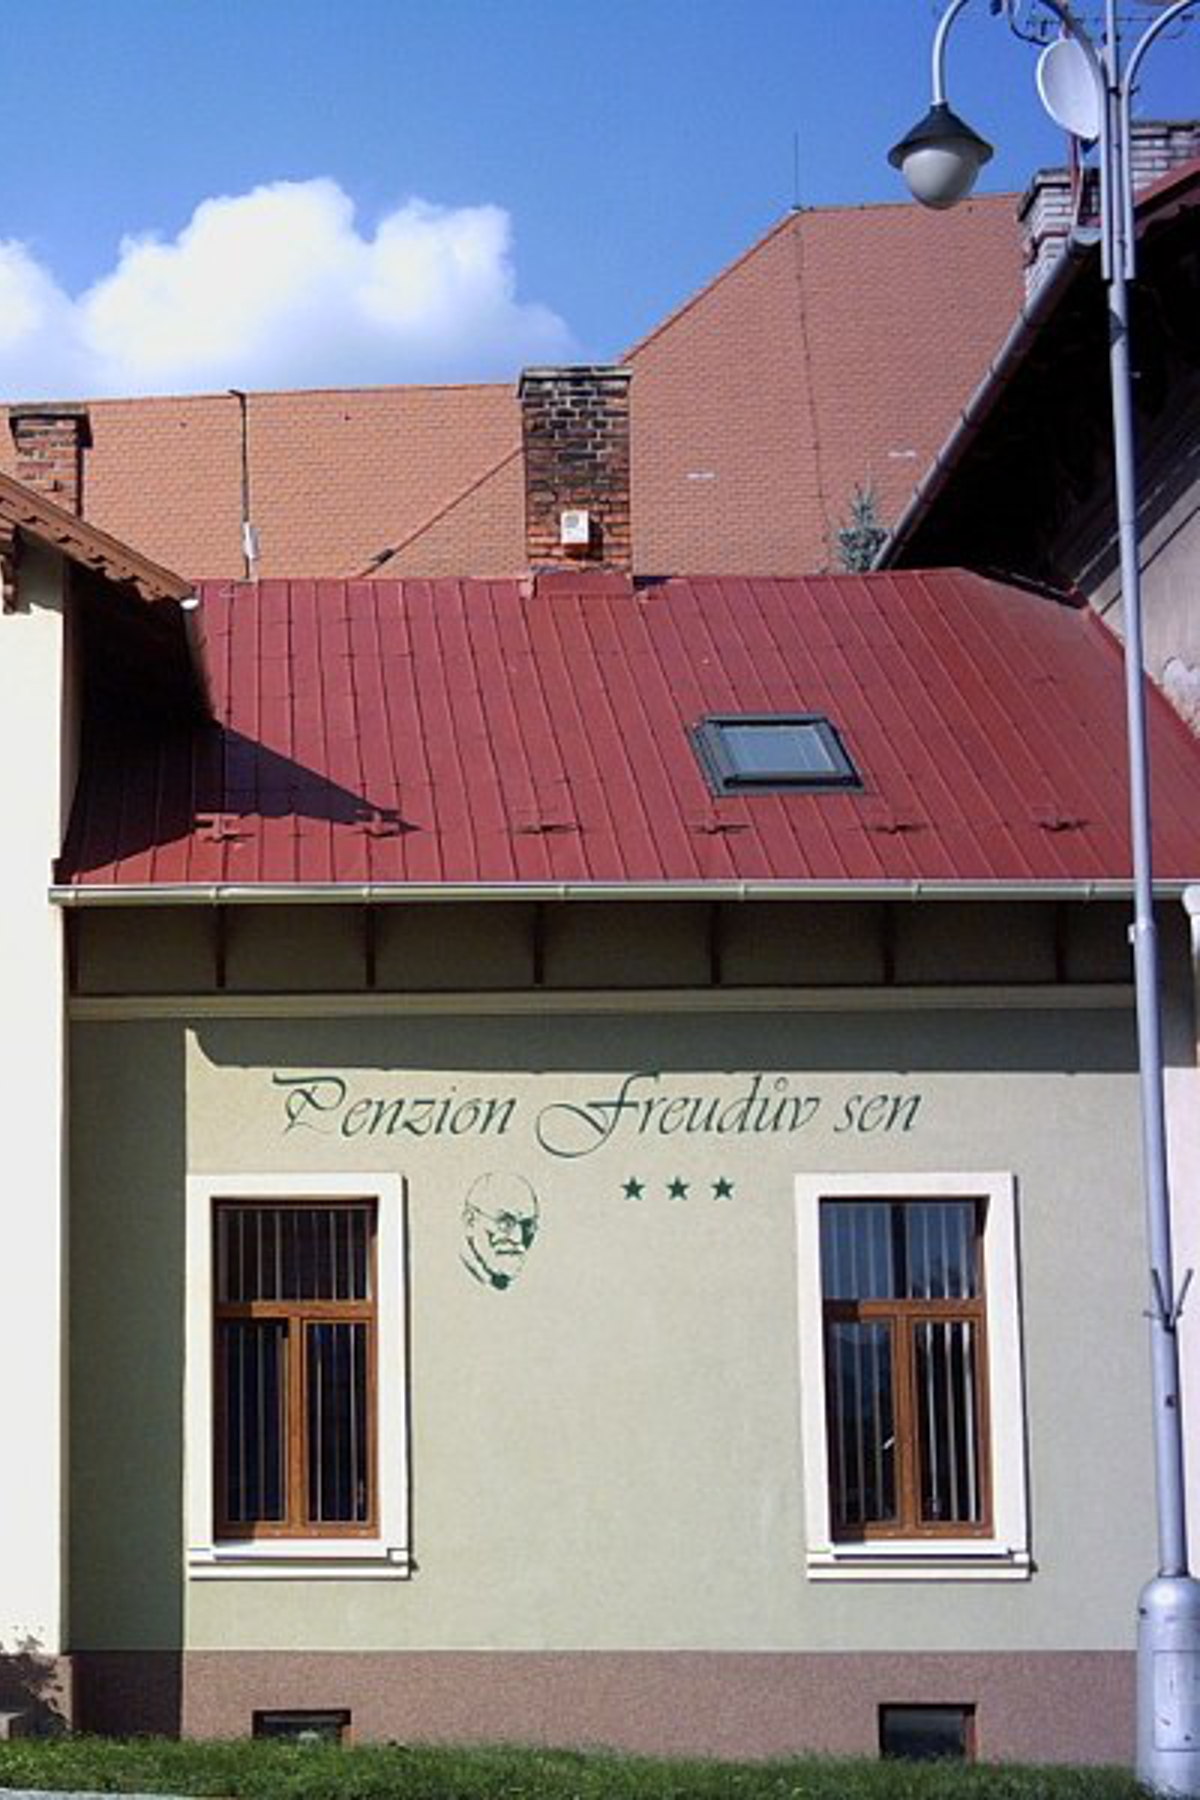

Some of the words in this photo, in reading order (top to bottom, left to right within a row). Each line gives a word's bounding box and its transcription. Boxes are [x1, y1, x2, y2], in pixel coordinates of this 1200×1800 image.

[271, 1073, 517, 1137] Penzion
[535, 1071, 819, 1158] Freudův
[834, 1087, 923, 1133] sen
